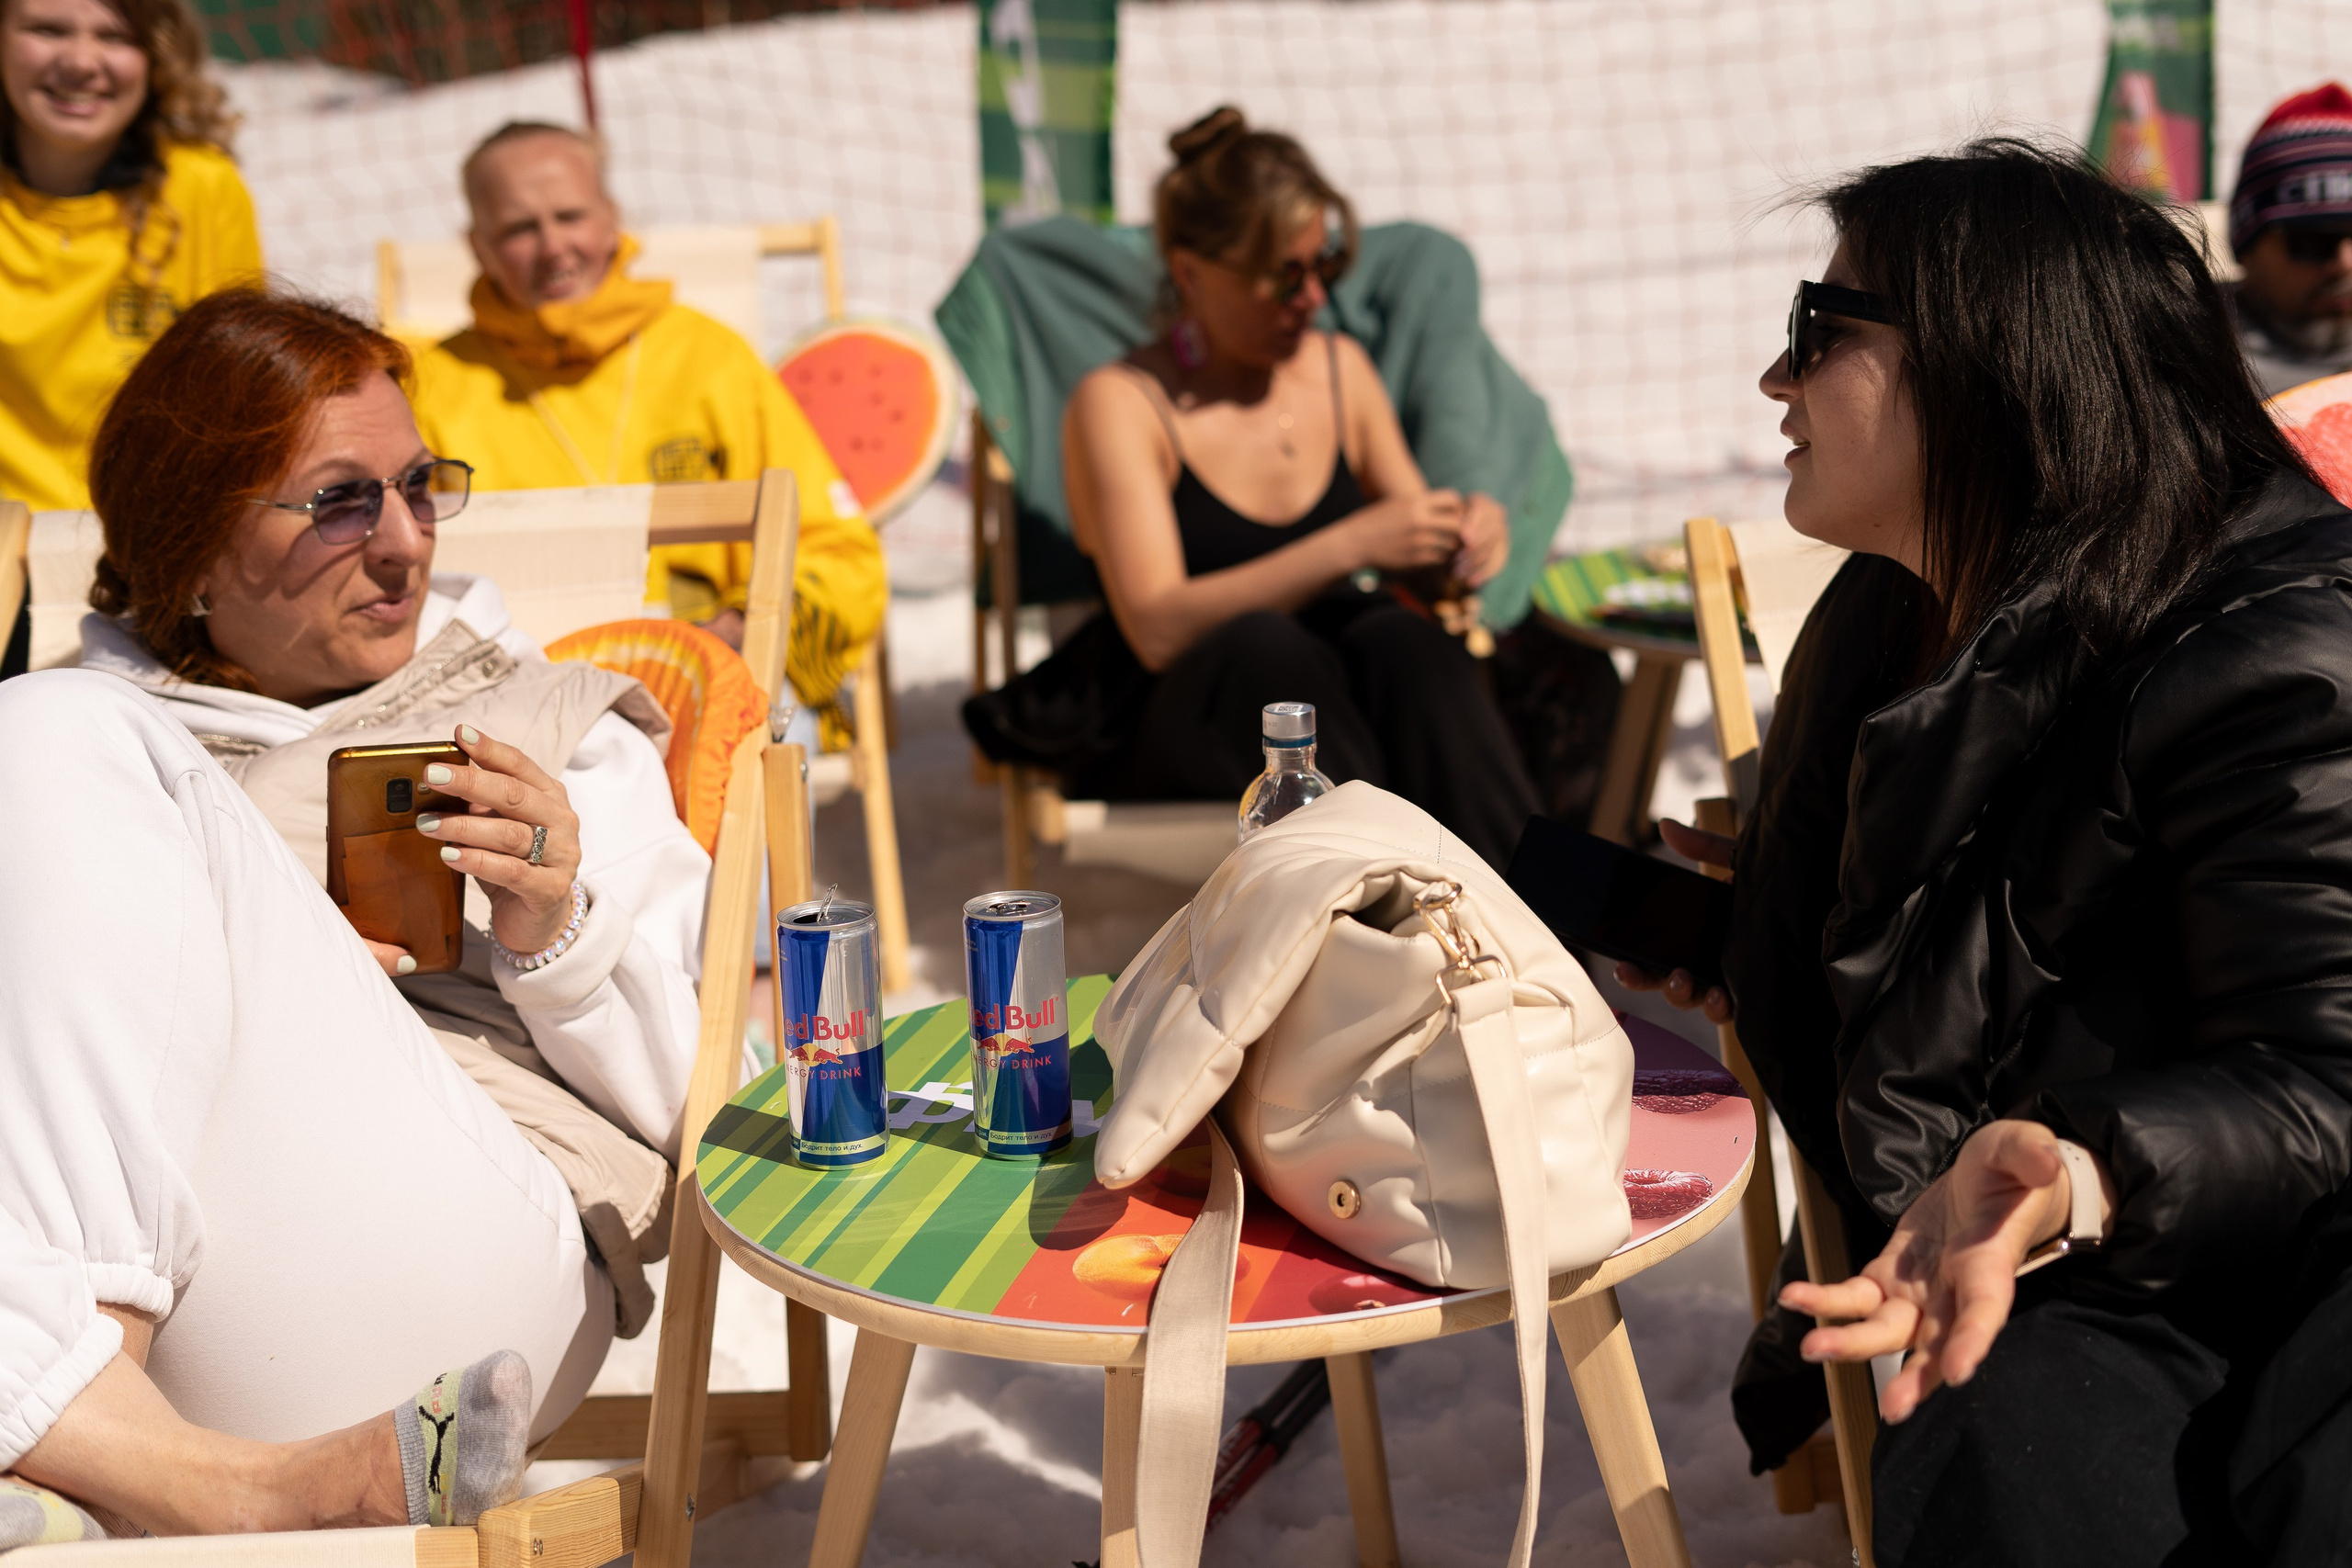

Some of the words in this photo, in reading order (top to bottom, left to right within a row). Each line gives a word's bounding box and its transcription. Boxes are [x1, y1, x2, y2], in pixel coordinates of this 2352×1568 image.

[972, 1003, 1001, 1030] ed
[1005, 998, 1055, 1030] Bull
[785, 1013, 809, 1040] ed
[812, 1010, 865, 1040] Bull
[1012, 1055, 1052, 1069] DRINK
[820, 1066, 862, 1080] DRINK
[989, 1132, 1013, 1142] Бодрит
[801, 1142, 823, 1151] Бодрит
[850, 1143, 864, 1151] дух.
